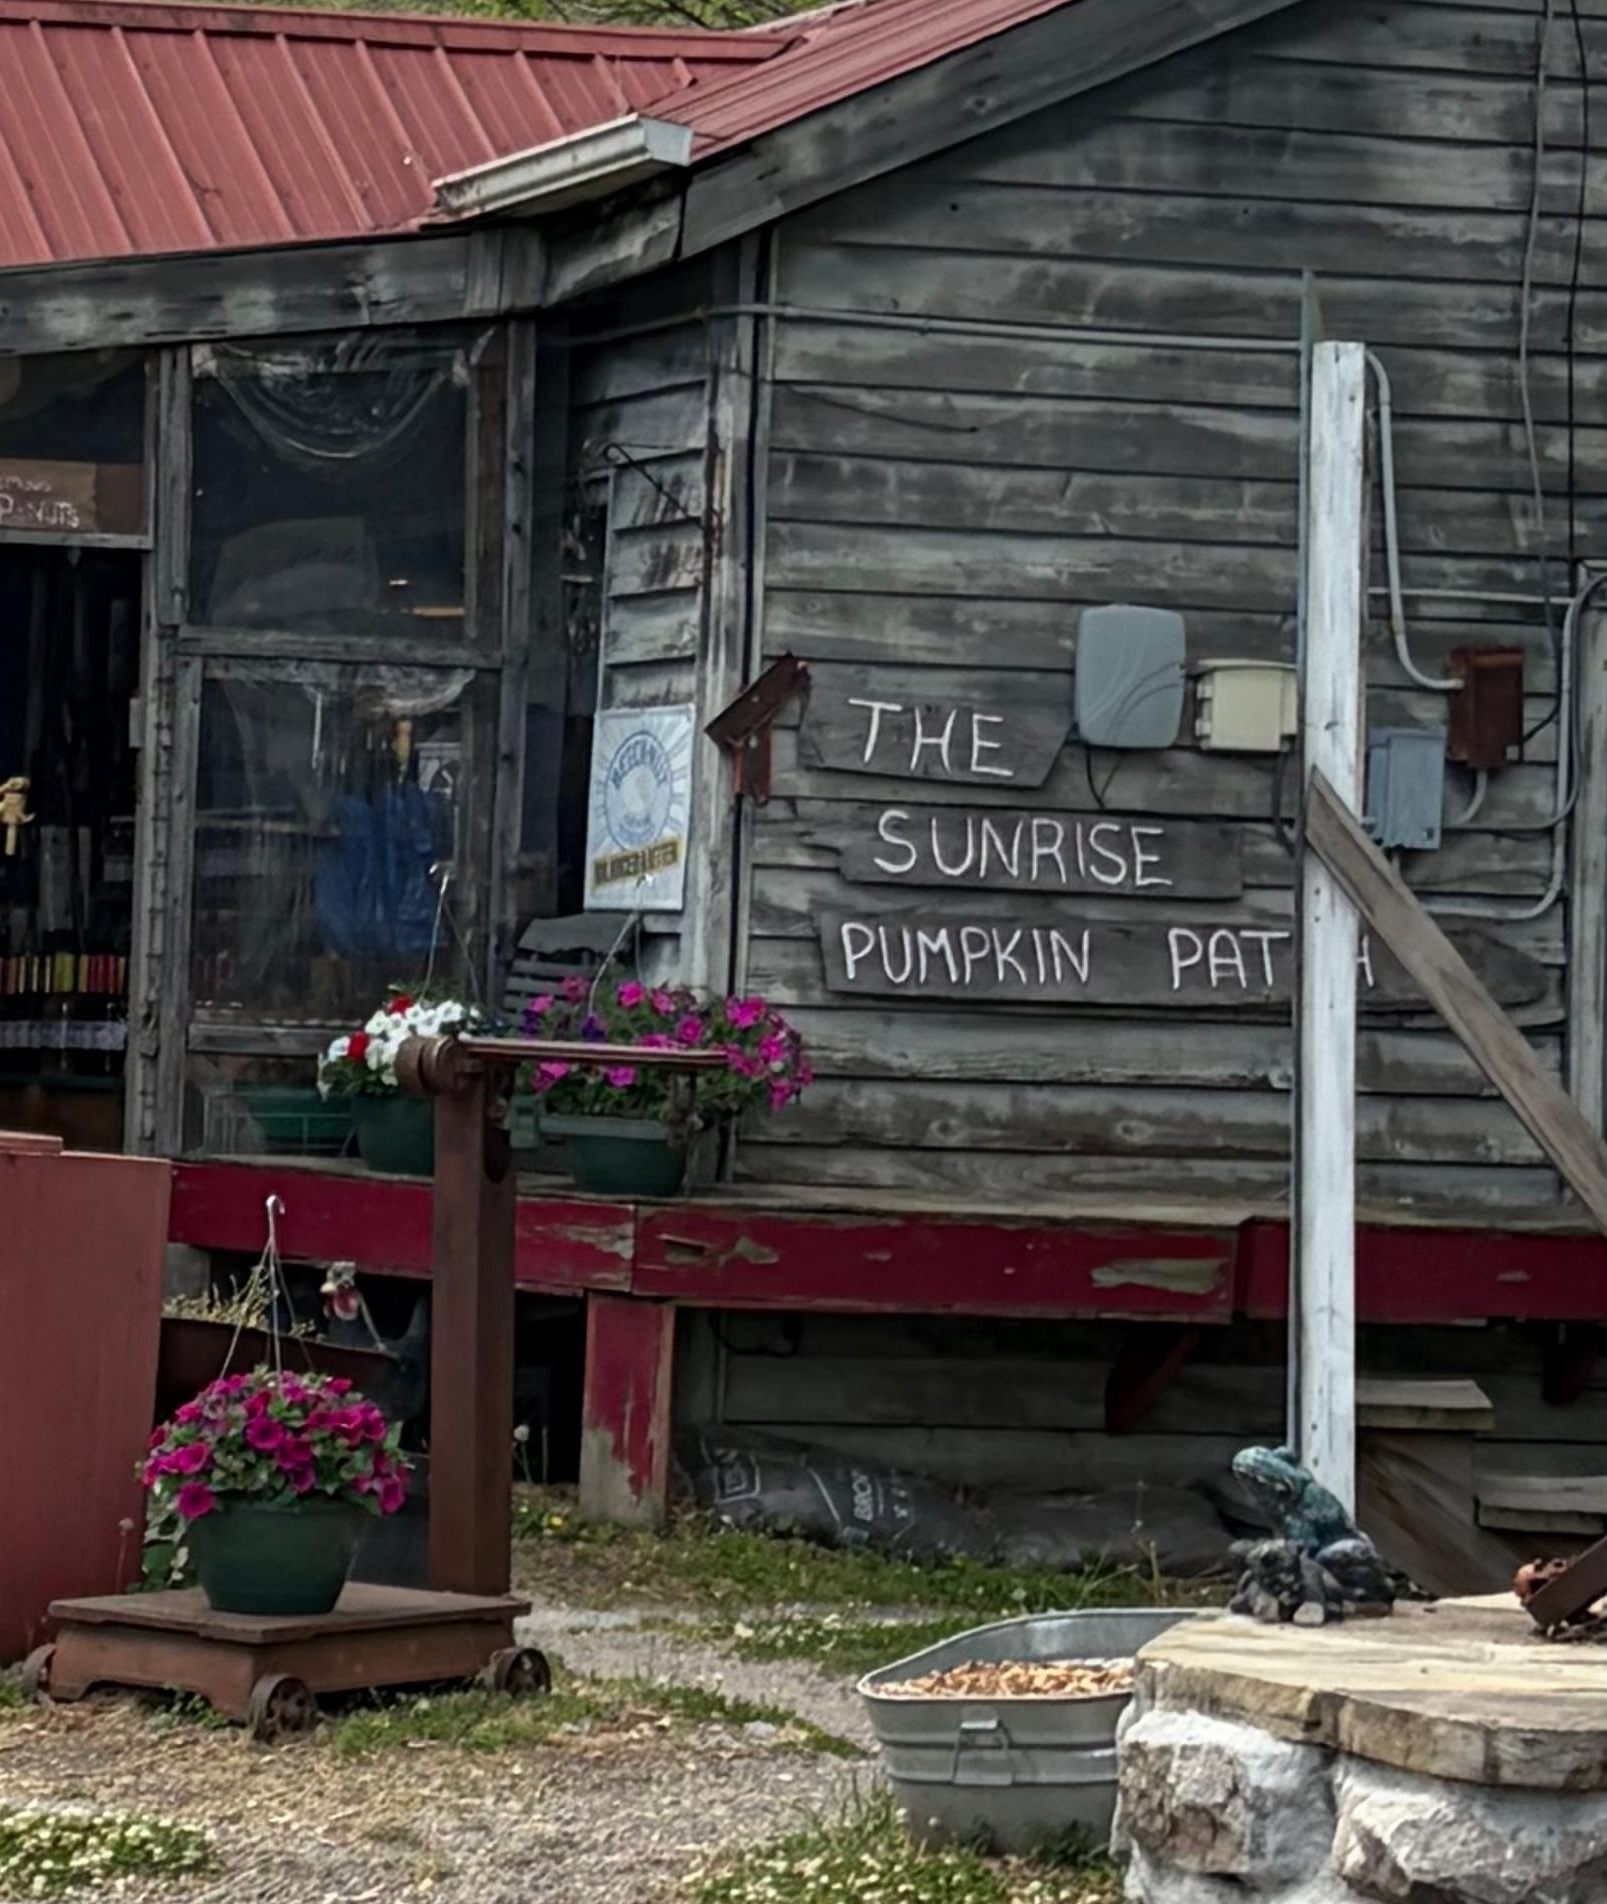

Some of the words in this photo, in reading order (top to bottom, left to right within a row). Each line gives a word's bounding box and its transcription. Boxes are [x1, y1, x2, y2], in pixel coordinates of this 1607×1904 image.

[848, 698, 1014, 778] THE
[873, 808, 1173, 888] SUNRISE
[840, 921, 1091, 986] PUMPKIN
[1166, 927, 1375, 990] PATH
